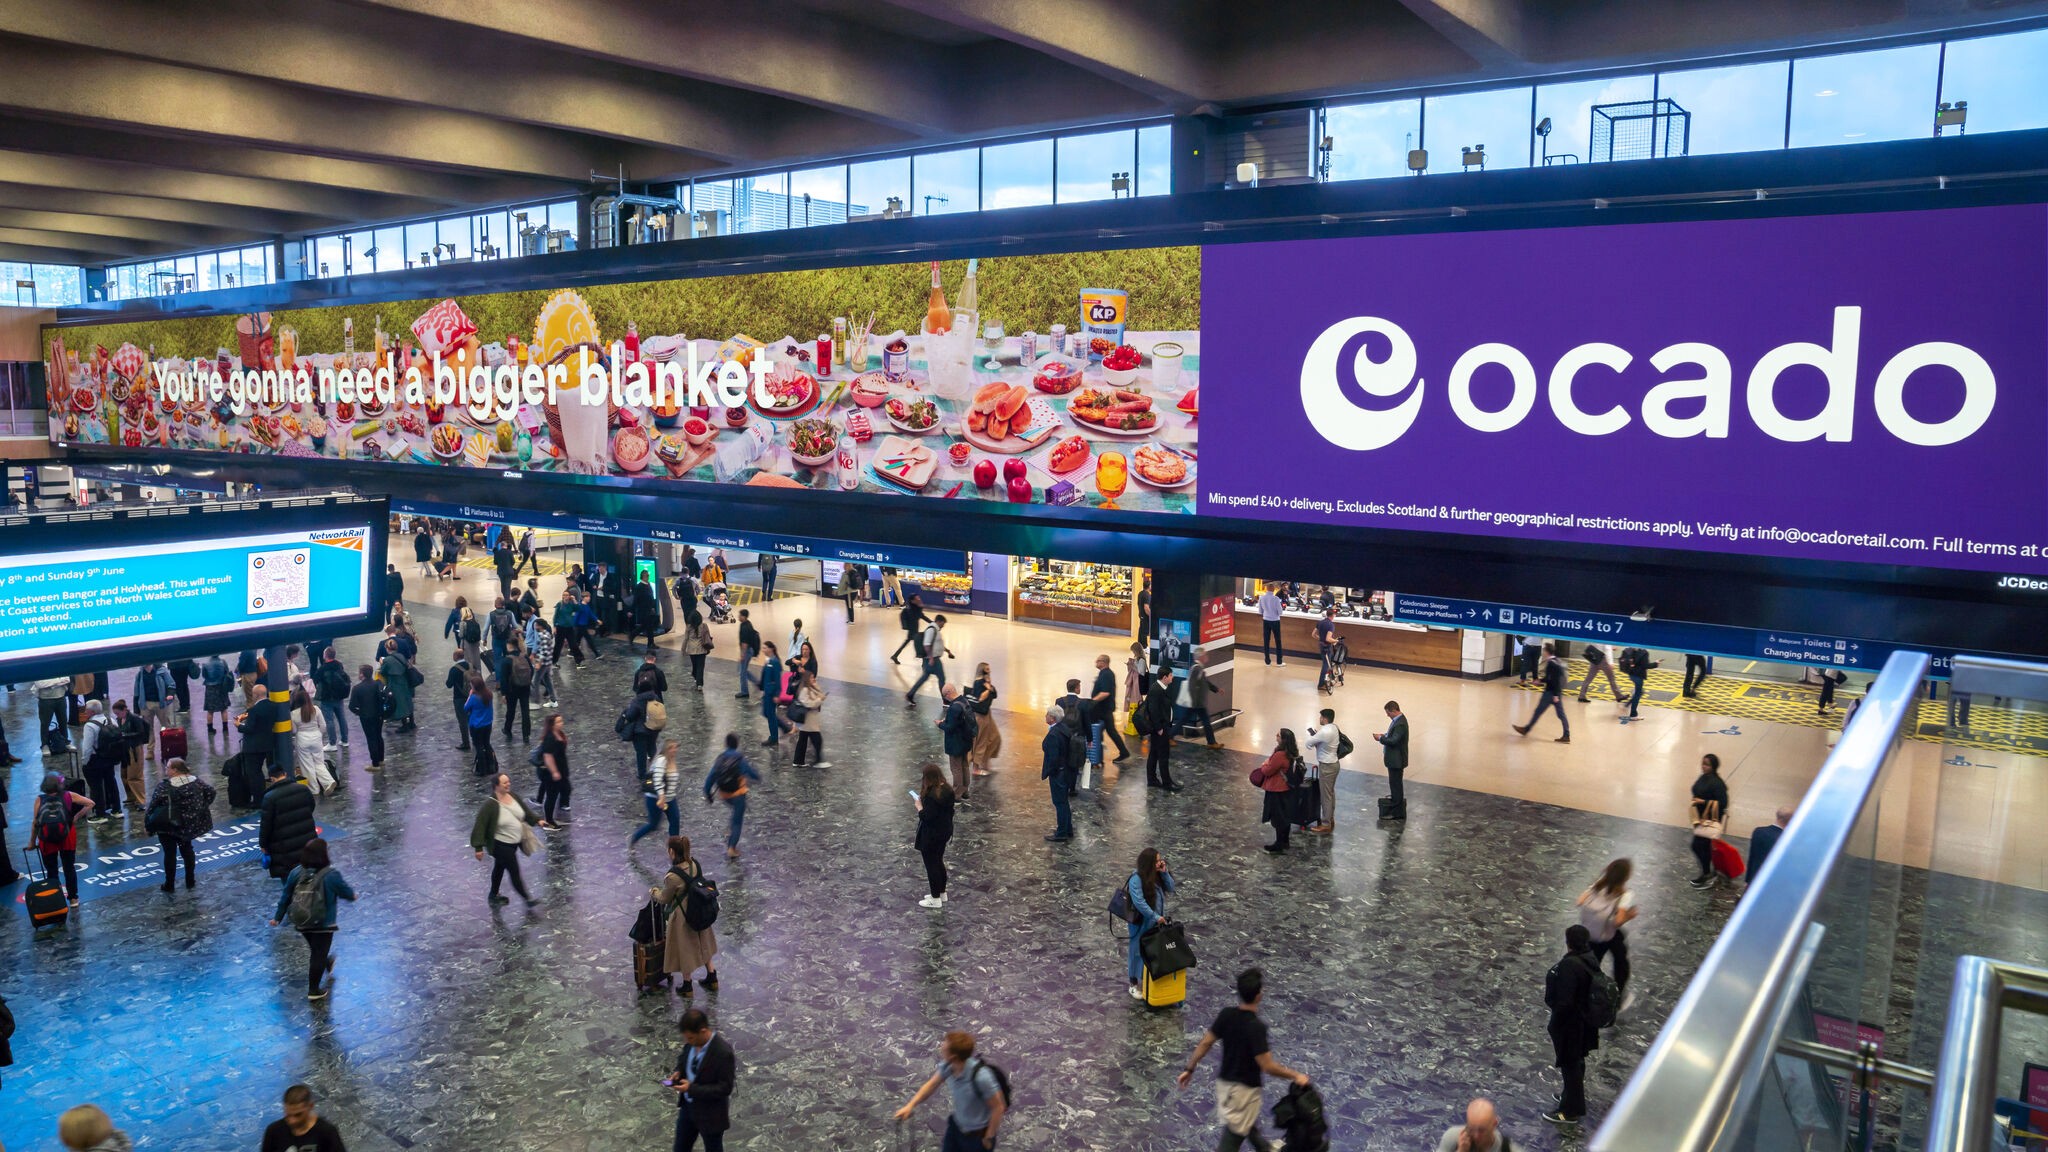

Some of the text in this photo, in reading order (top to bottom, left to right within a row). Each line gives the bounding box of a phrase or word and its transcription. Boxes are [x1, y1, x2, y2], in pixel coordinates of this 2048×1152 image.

[1093, 308, 1114, 319] KP
[152, 341, 777, 421] You're gonna need a bigger blanket
[1448, 306, 1997, 446] ocado
[1208, 492, 1227, 504] Min
[1228, 495, 1259, 508] spend
[1261, 495, 1281, 508] £40
[1282, 499, 1289, 507] +
[1290, 498, 1335, 514] delivery.
[1337, 500, 1385, 515] Excludes
[1387, 503, 1437, 518] Scotland
[1439, 507, 1449, 519] &
[1450, 506, 1493, 522] further
[1494, 512, 1575, 528] geographical
[1577, 516, 1650, 532] restrictions
[1652, 521, 1694, 538] apply.
[1697, 522, 1739, 541] Verify
[1740, 526, 1756, 539] at
[1757, 526, 1929, 551] info@ocadoretail.com.
[1932, 536, 1963, 553] Full
[1966, 540, 2017, 556] terms
[2020, 543, 2038, 558] at
[780, 544, 796, 552] Toilets
[839, 550, 875, 560] Changing Places
[8, 574, 22, 584] 8th
[25, 573, 45, 583] and
[47, 570, 85, 581] Sunday
[87, 568, 100, 577] 9th
[102, 567, 125, 576] June
[14, 593, 60, 605] between
[62, 589, 98, 600] Bangor
[100, 586, 119, 596] and
[120, 581, 167, 595] Holyhead.
[170, 579, 188, 589] This
[189, 577, 205, 587] will
[207, 575, 232, 585] result
[7, 606, 37, 616] Coast
[39, 602, 81, 613] services
[82, 600, 94, 608] to
[95, 598, 112, 606] the
[114, 594, 142, 605] North
[144, 591, 173, 601] Wales
[174, 588, 199, 598] Coast
[201, 586, 217, 595] this
[1429, 602, 1449, 611] Sleeper
[22, 612, 72, 625] weekend.
[1399, 607, 1415, 615] Guest
[1415, 608, 1435, 618] Lounge
[1435, 610, 1458, 619] Platform
[27, 626, 39, 635] at
[40, 612, 153, 634] www.nationalrail.co.uk
[1519, 612, 1624, 634] Platforms 4 to 7
[1803, 638, 1831, 648] Toilets
[1763, 647, 1831, 662] Changing Places
[84, 861, 160, 884] please
[99, 867, 165, 887] when
